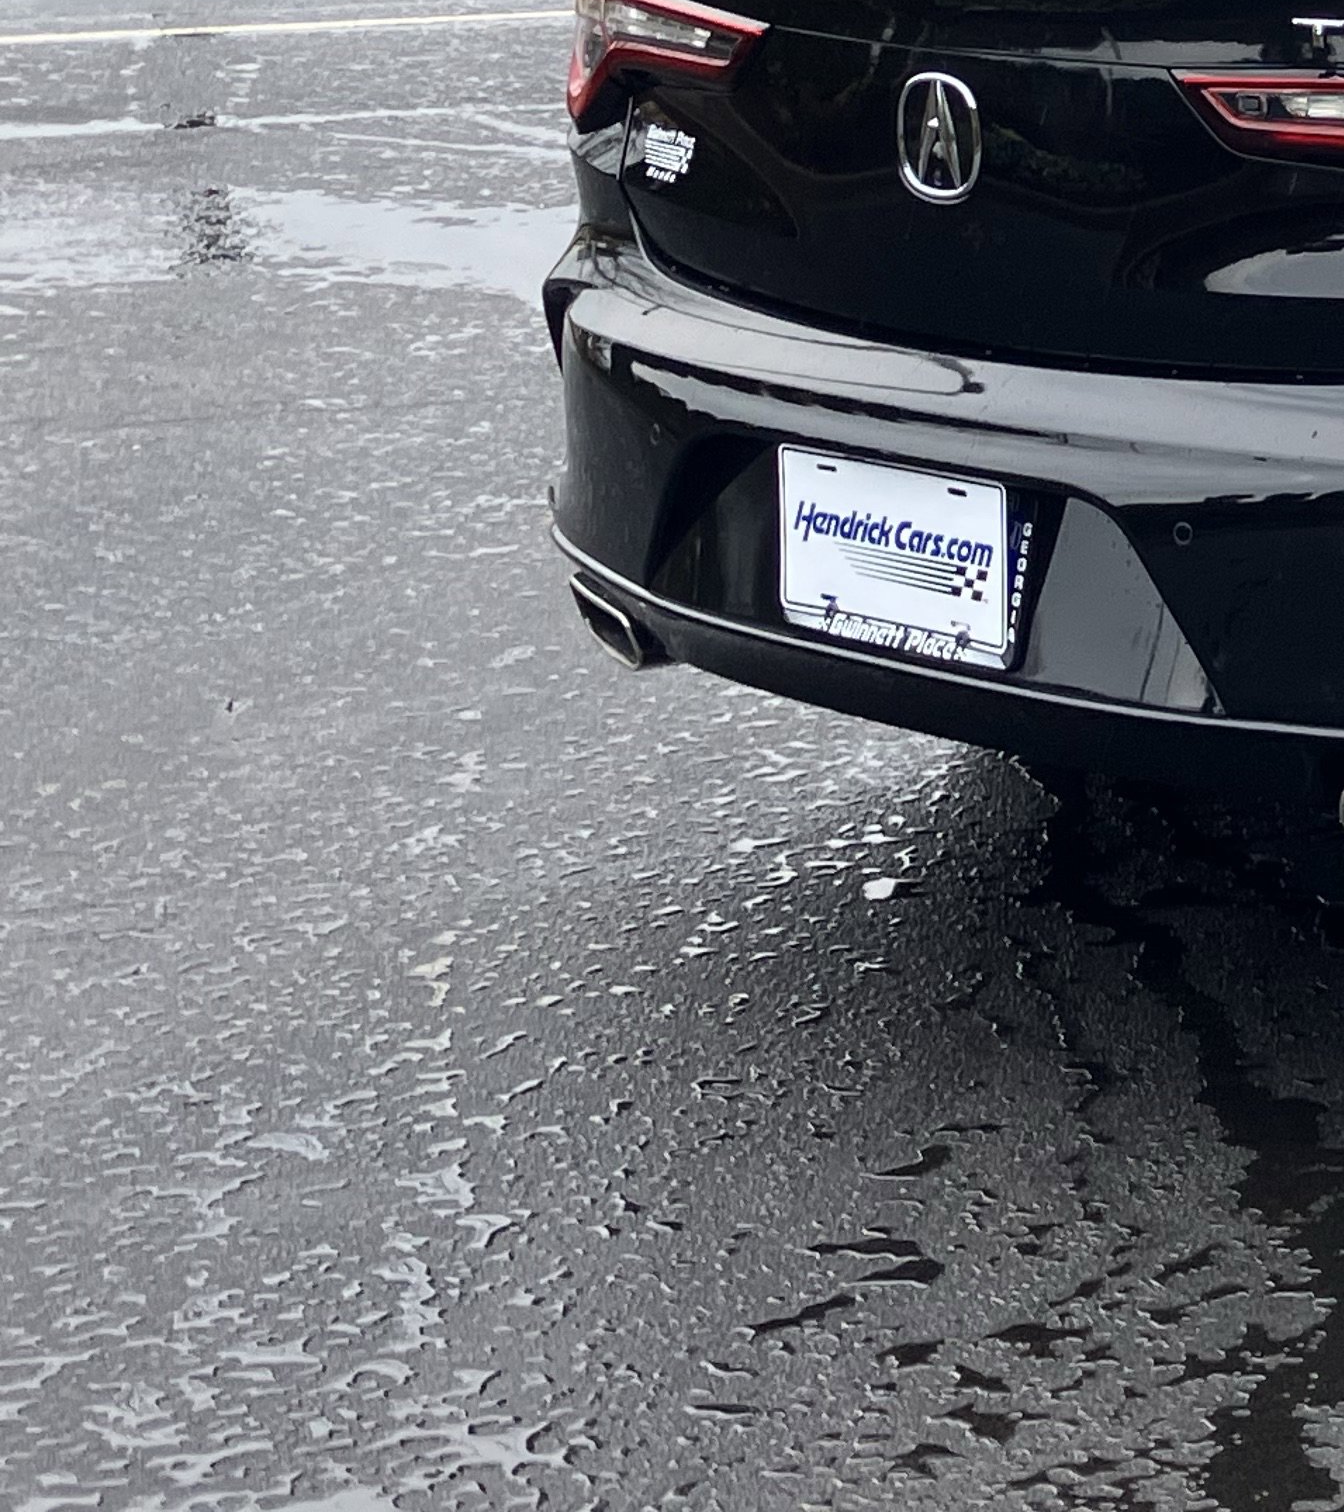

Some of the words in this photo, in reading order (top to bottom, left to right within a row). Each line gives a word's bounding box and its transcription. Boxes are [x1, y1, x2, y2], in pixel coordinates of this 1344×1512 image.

[1007, 521, 1034, 644] GEORGIA
[829, 612, 904, 648] Gwinnett
[904, 628, 956, 660] Place
